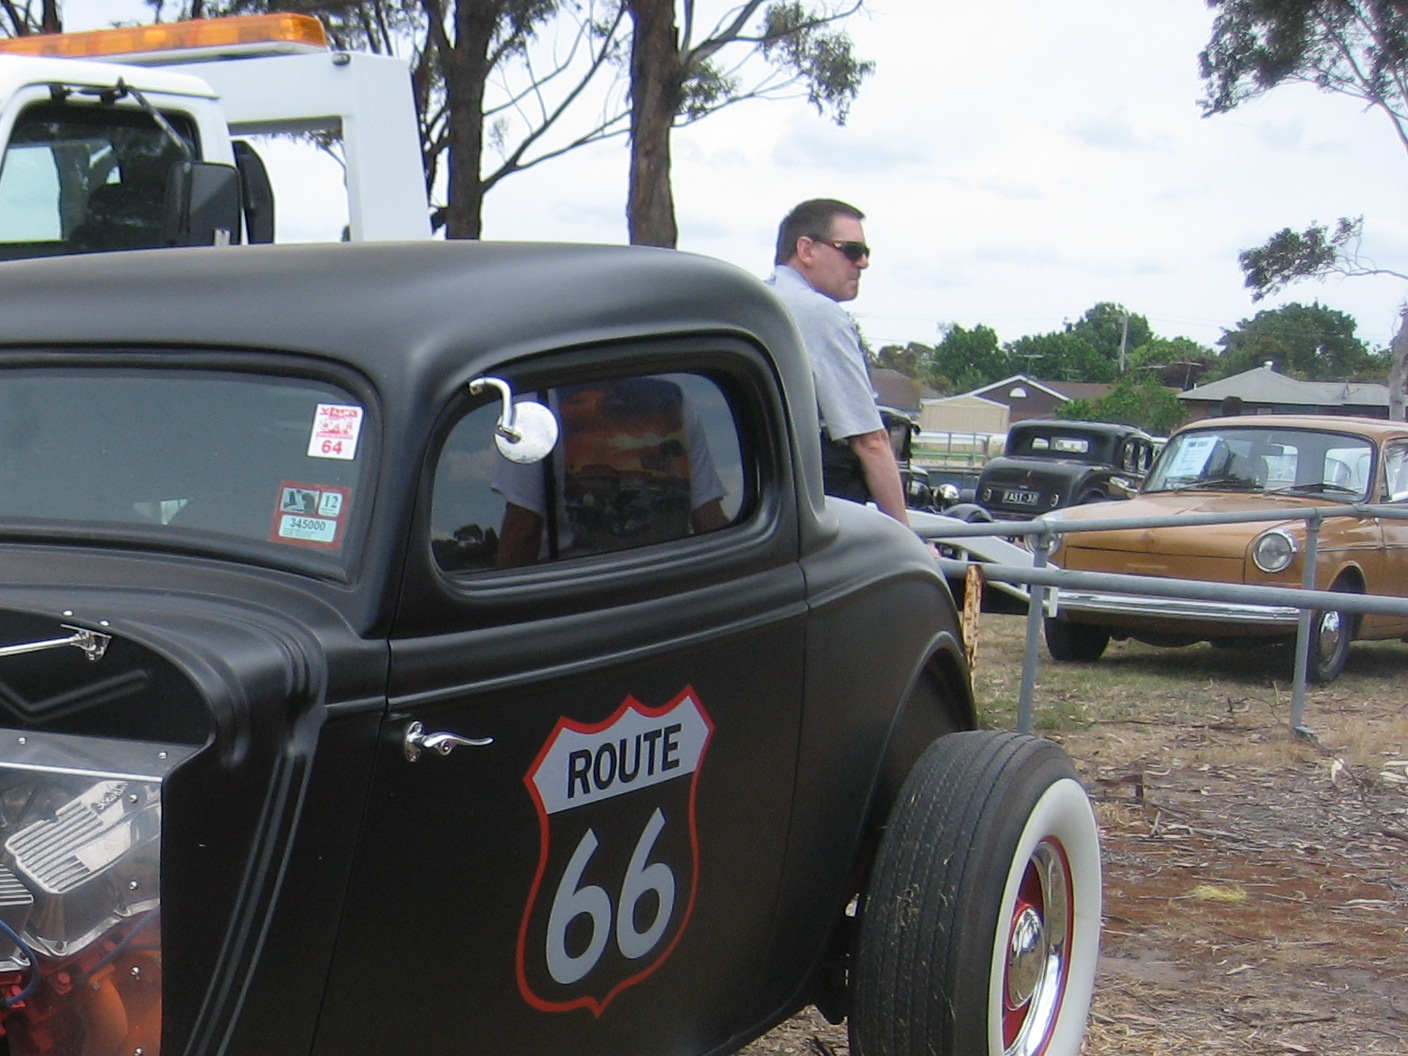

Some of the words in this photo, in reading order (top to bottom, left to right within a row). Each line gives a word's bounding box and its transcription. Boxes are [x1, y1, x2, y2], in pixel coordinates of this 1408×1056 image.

[321, 439, 343, 454] 64
[324, 494, 339, 508] 12
[290, 517, 327, 531] 345000
[567, 722, 682, 799] ROUTE
[545, 806, 676, 986] 66
